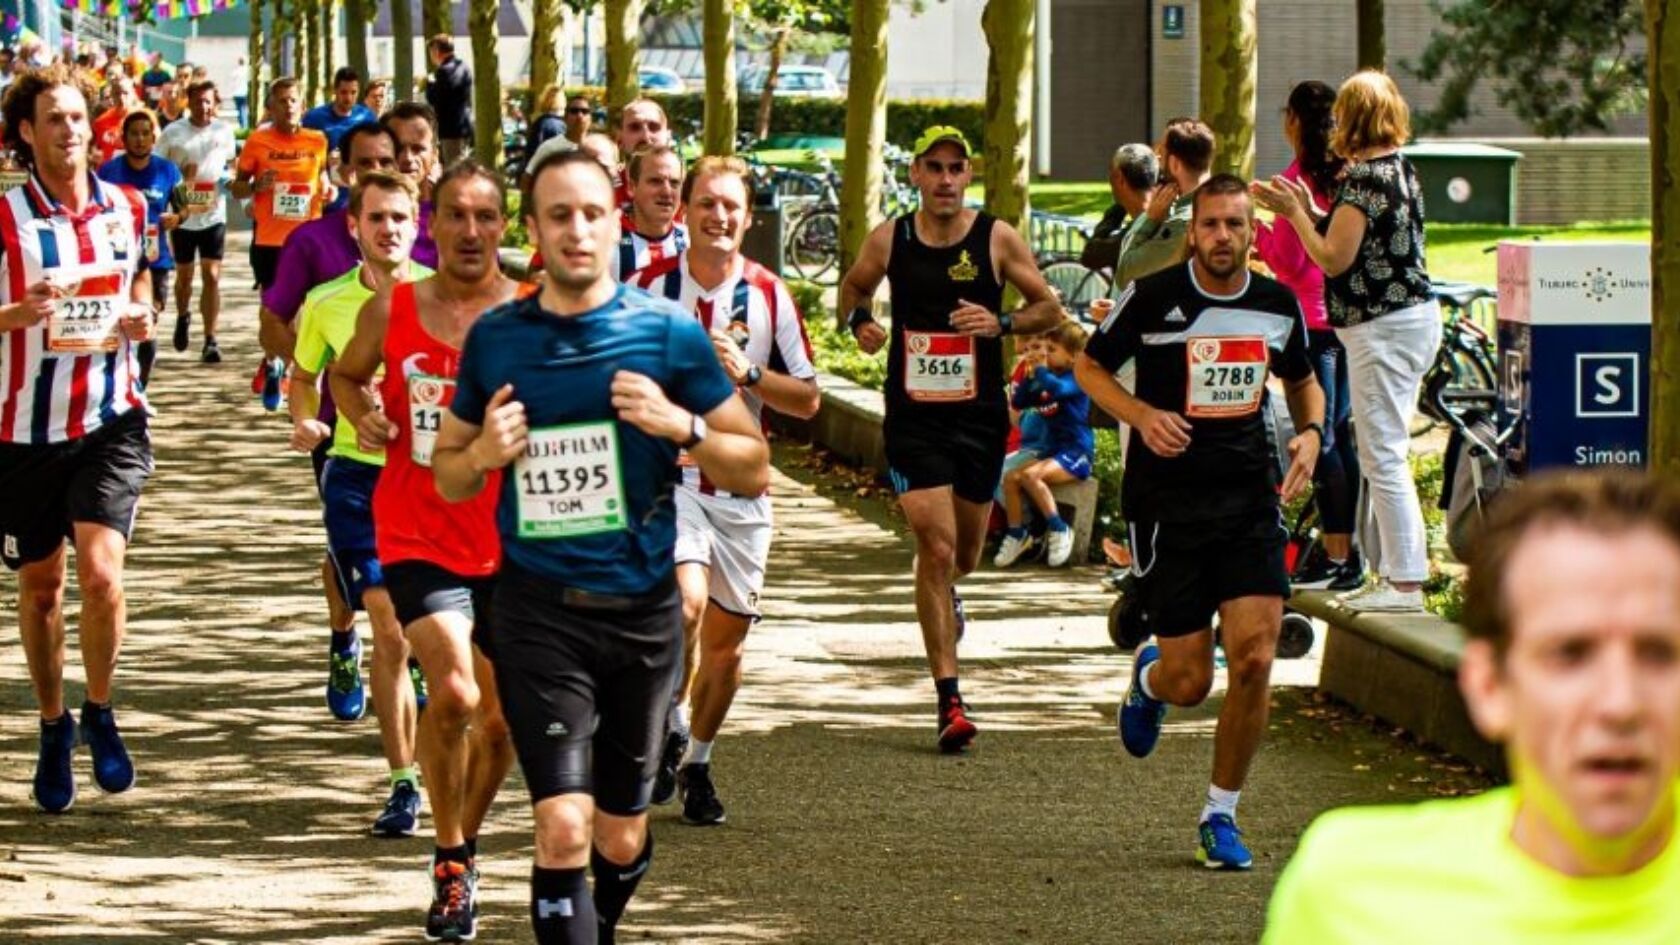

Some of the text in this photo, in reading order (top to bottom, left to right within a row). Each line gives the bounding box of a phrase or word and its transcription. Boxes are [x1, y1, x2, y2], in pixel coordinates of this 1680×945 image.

[63, 300, 112, 321] 2223
[917, 357, 962, 375] 3616
[1203, 366, 1255, 387] 2788
[1212, 390, 1244, 401] ROBIN
[1594, 366, 1621, 404] S
[415, 408, 441, 431] 11
[525, 435, 609, 458] UJIFILM
[1575, 446, 1640, 464] Simon
[522, 463, 609, 495] 11395
[547, 499, 584, 515] TOM
